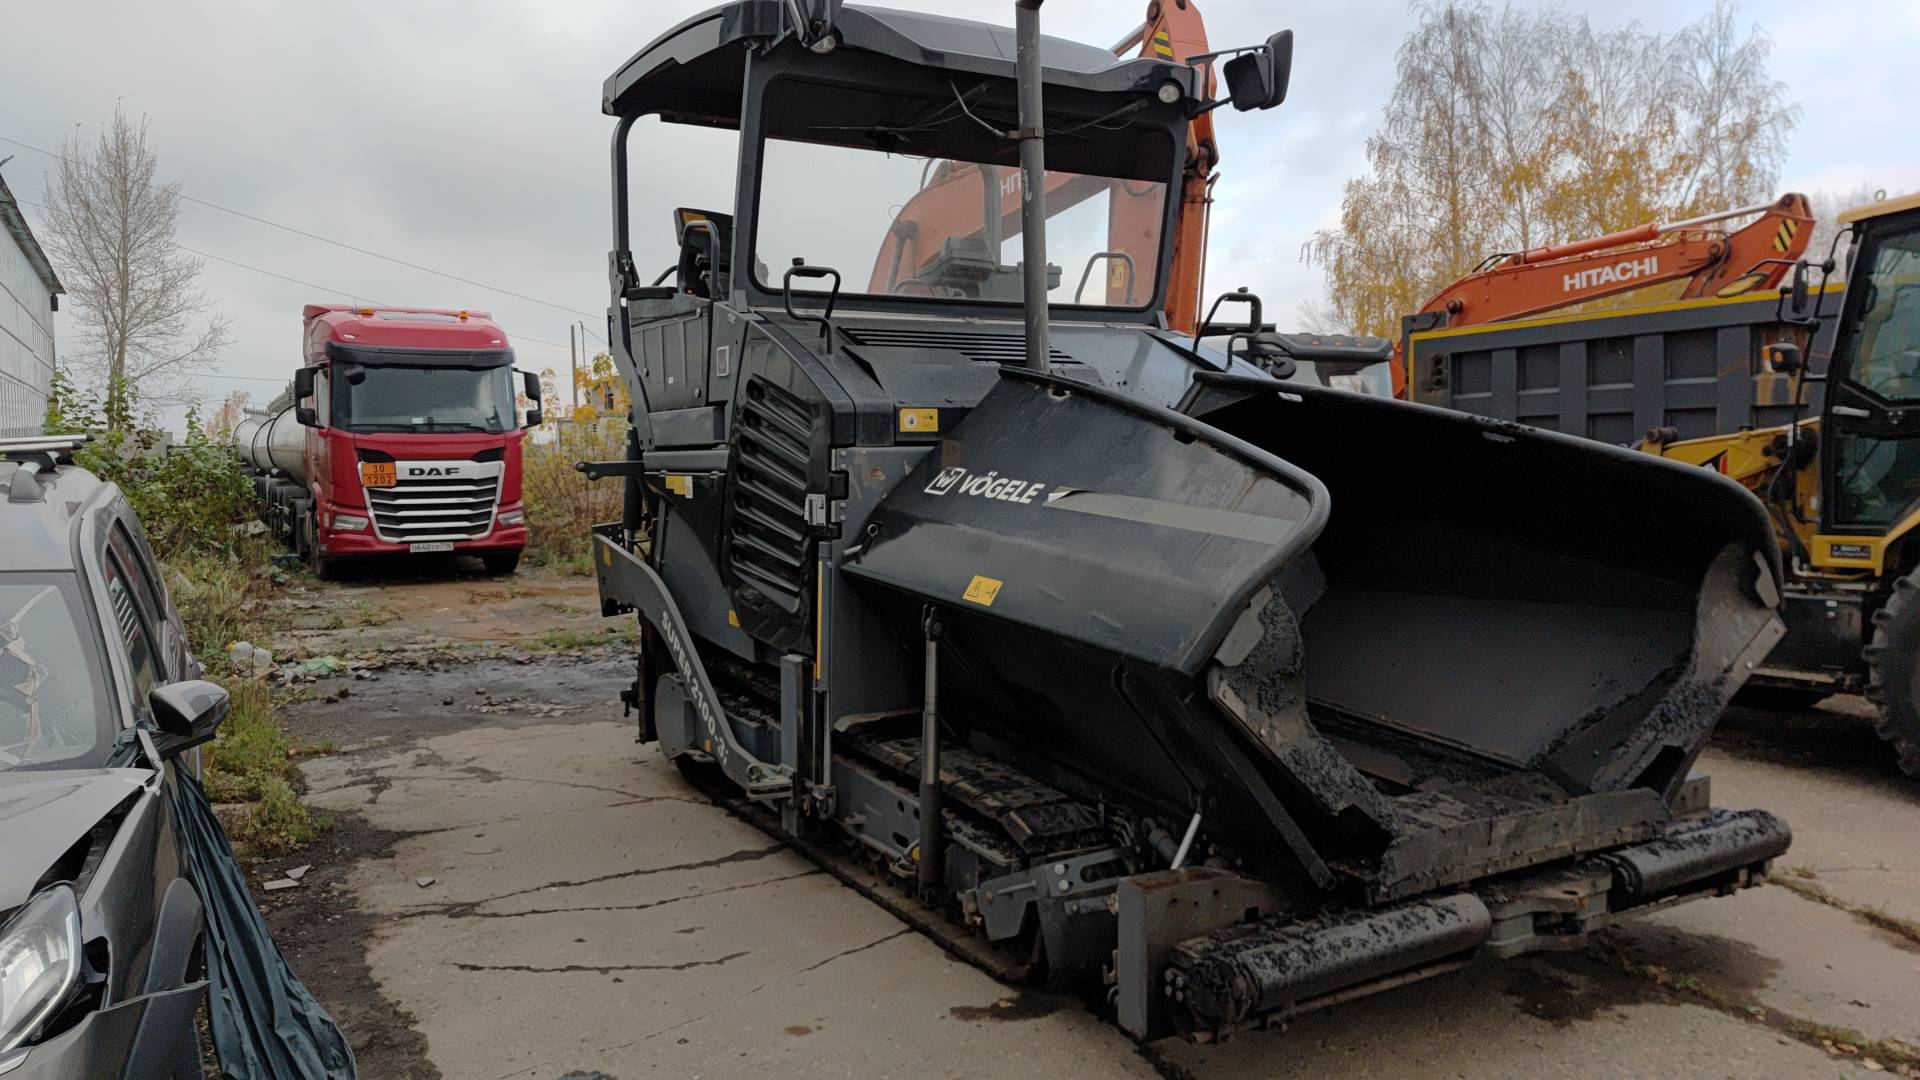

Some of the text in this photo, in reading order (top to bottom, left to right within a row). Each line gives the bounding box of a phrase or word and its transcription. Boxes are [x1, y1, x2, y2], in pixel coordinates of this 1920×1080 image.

[1563, 256, 1658, 292] HITACHI
[367, 475, 393, 485] 1202
[372, 464, 385, 474] 30
[408, 467, 460, 476] DAF
[958, 470, 1045, 504] VÖGELE
[662, 611, 729, 766] SUPER 2100-3i
